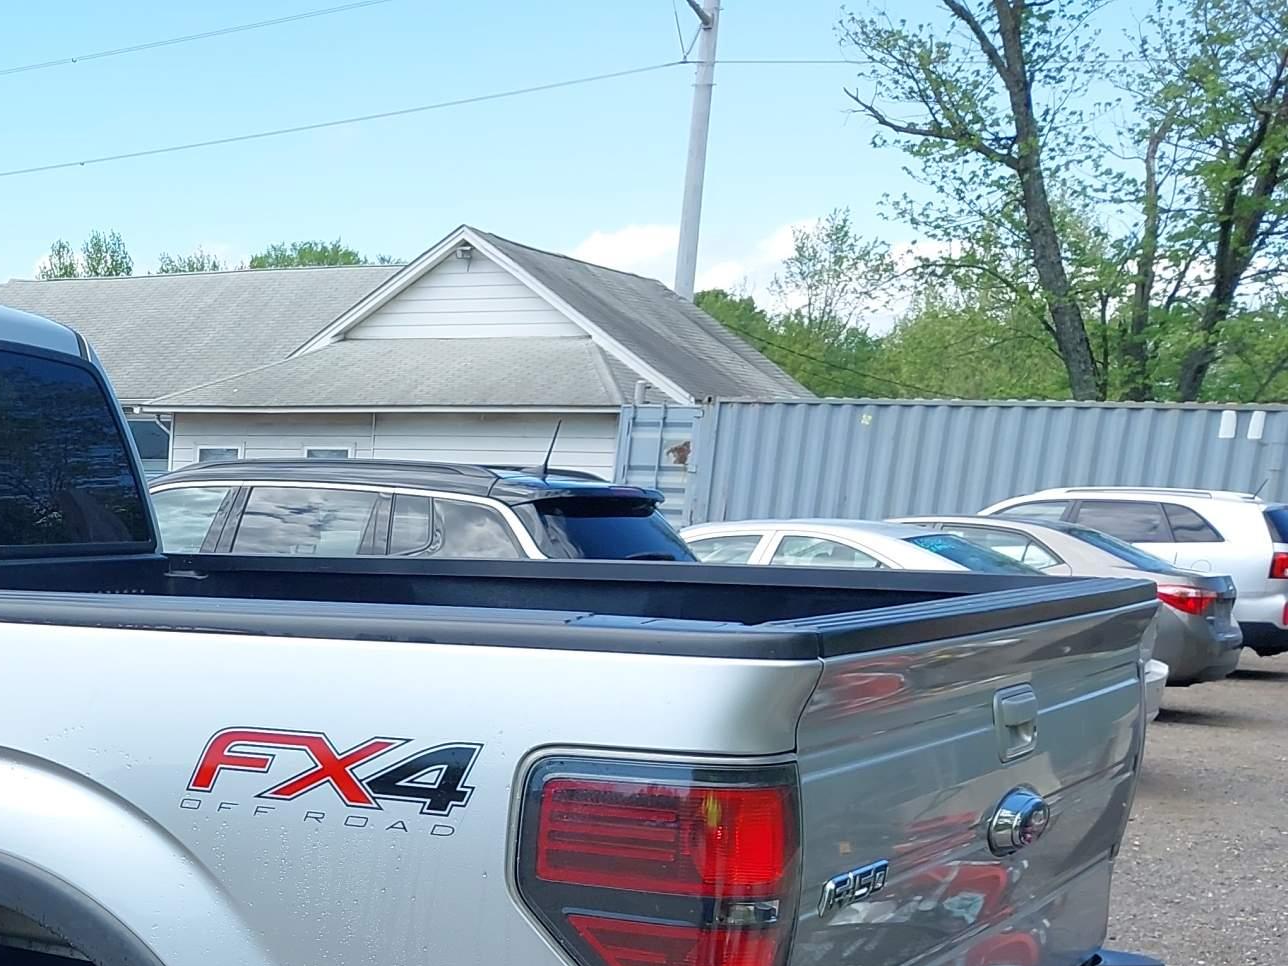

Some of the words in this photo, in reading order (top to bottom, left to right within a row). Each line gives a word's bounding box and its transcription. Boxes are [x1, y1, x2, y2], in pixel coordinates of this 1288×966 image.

[186, 726, 485, 817] FX4
[179, 797, 276, 817] OFF
[303, 811, 456, 838] ROAD
